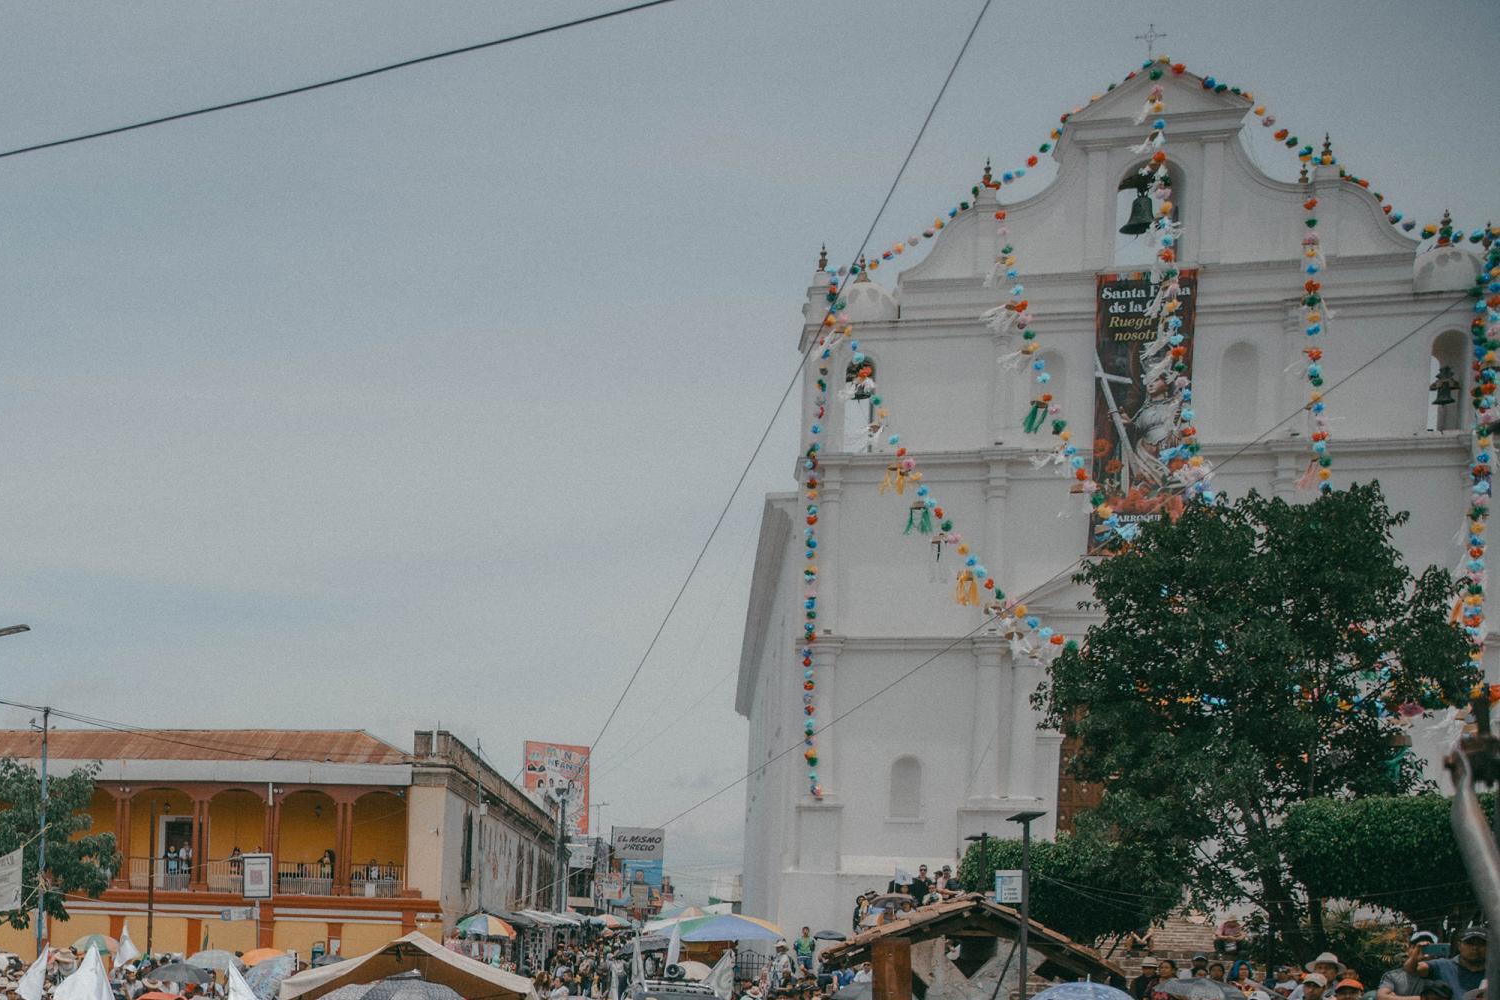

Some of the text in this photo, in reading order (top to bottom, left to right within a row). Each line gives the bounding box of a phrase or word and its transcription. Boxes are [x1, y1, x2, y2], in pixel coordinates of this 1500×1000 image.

[1102, 287, 1146, 300] Santa
[1108, 301, 1126, 314] de
[1129, 300, 1143, 313] la
[1109, 316, 1153, 330] Ruega
[617, 835, 662, 844] EL MISMO
[622, 843, 655, 852] PRECIO
